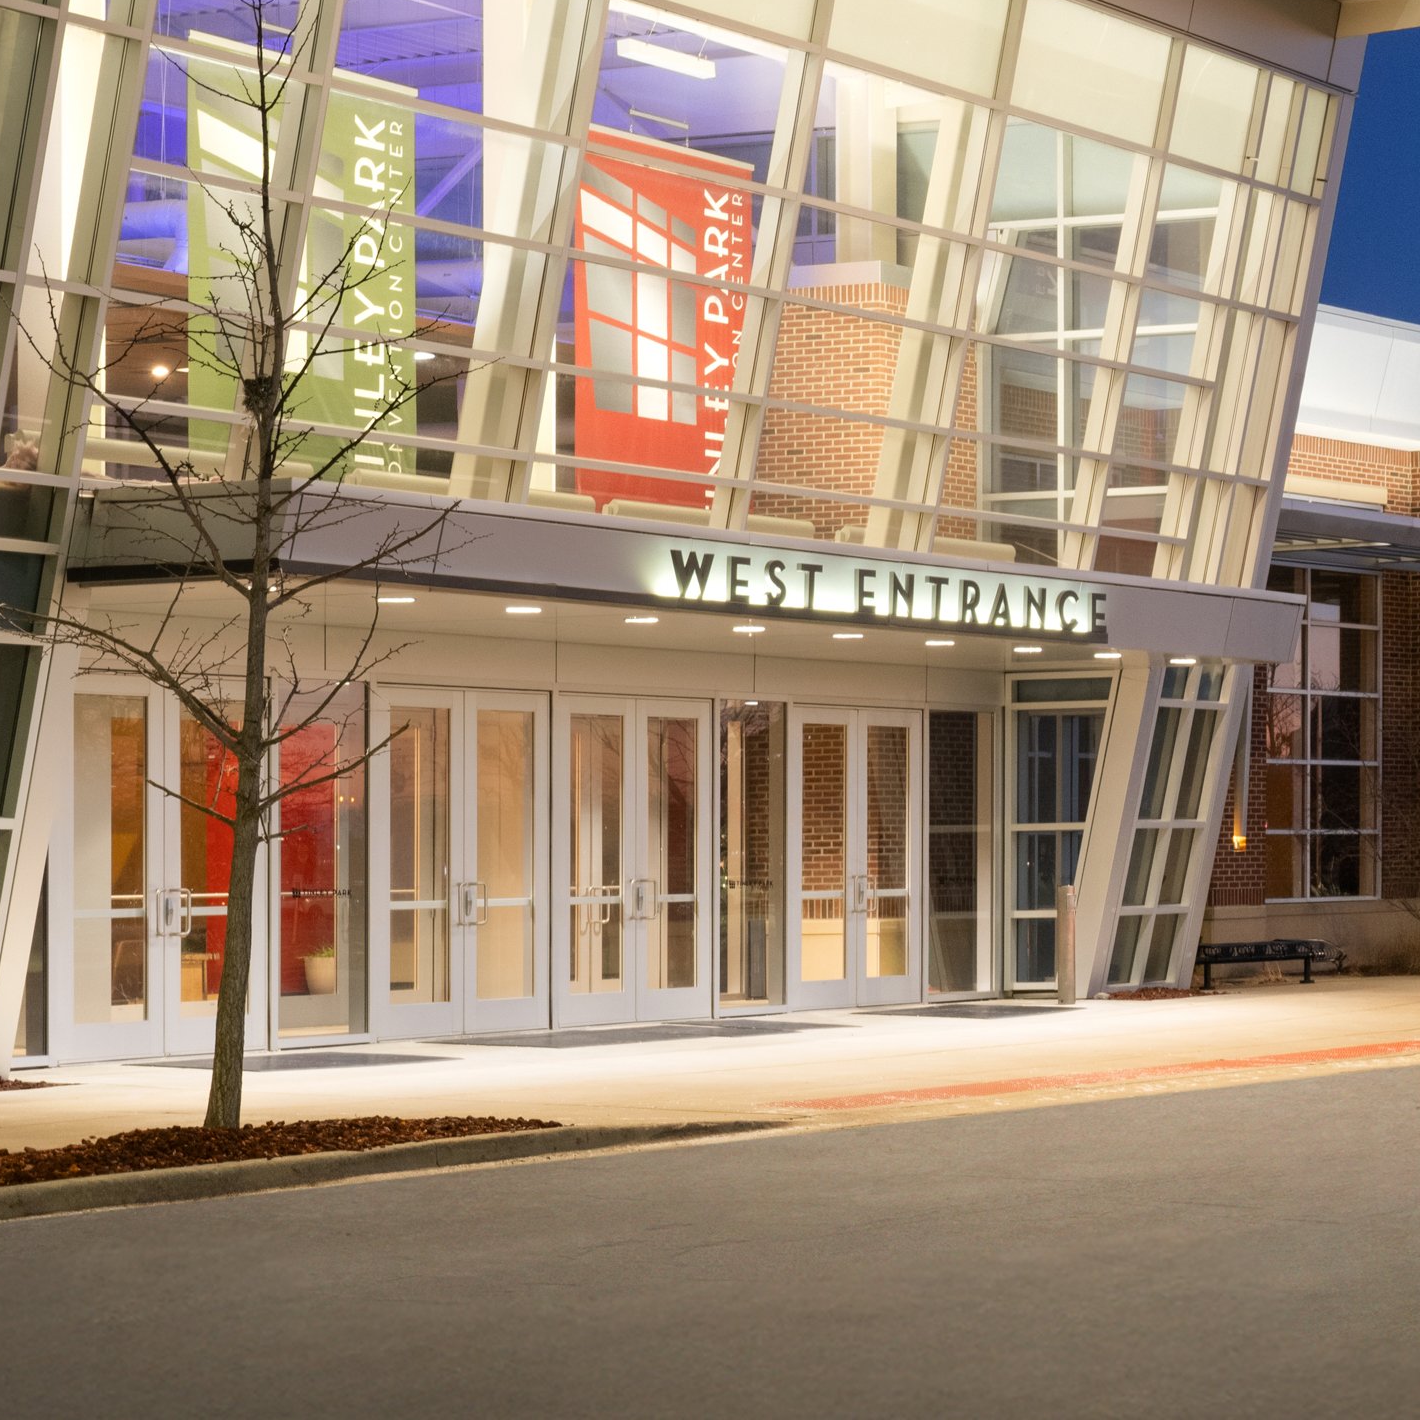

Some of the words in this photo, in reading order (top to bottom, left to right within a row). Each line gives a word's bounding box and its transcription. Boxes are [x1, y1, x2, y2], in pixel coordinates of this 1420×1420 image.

[354, 113, 386, 268] PARK
[703, 187, 729, 325] PARK
[731, 192, 744, 312] CENTER
[354, 287, 386, 467] INLEY
[388, 274, 404, 474] ONVENTION
[704, 341, 729, 510] NLEY
[670, 549, 823, 610] WEST
[854, 568, 1107, 634] ENTRANCE
